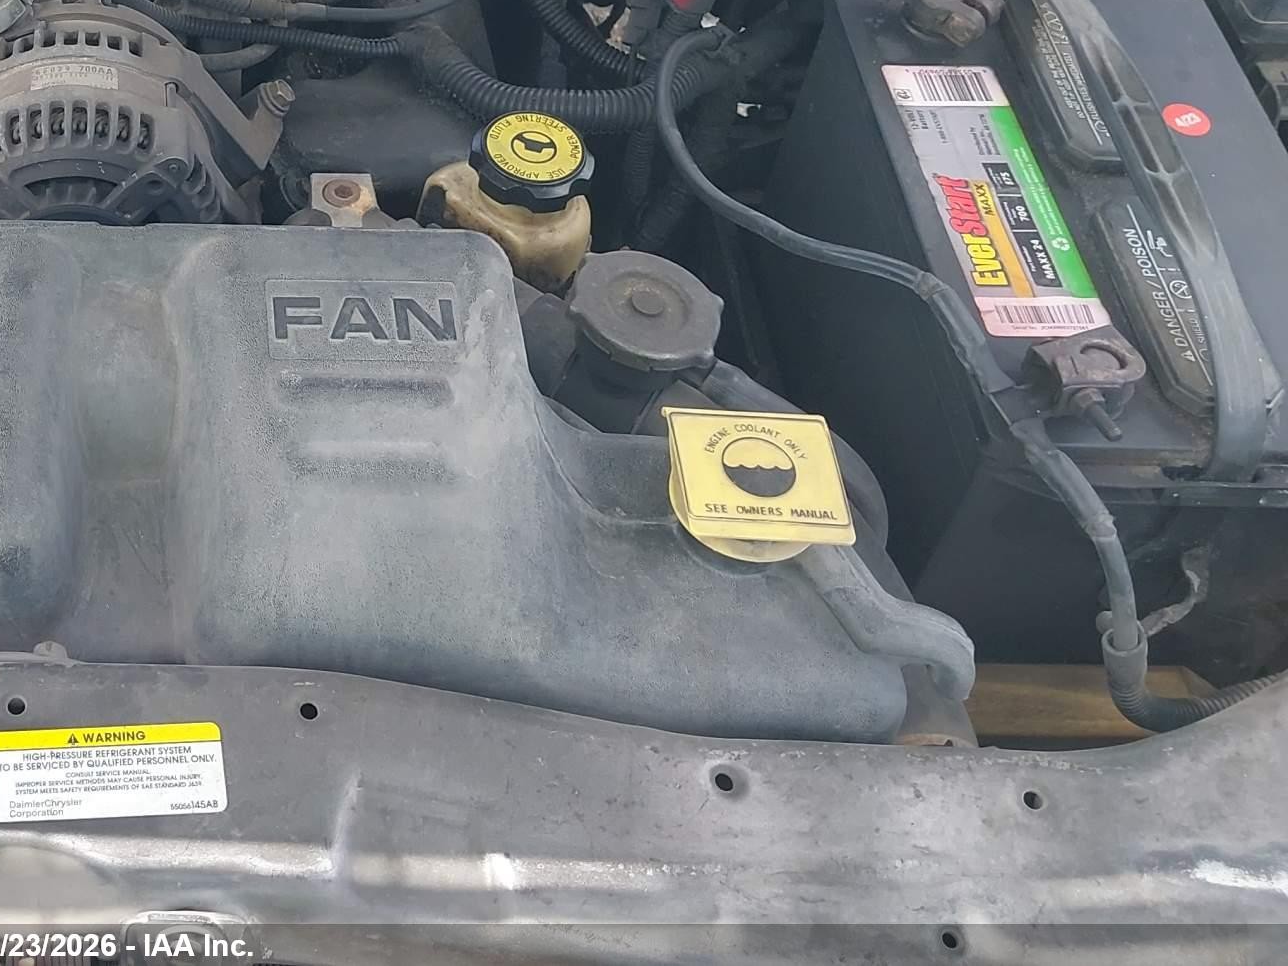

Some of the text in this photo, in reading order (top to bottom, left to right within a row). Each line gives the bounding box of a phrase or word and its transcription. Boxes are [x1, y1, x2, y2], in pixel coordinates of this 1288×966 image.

[489, 114, 581, 179] USE APPROVED POWER STEERING FLUID
[974, 183, 995, 216] MAXX
[1015, 205, 1031, 222] 700
[934, 174, 1010, 287] EverStart
[1029, 239, 1056, 280] MAXX 24
[1122, 228, 1157, 277] POISON
[272, 296, 457, 342] FAN
[1152, 291, 1189, 347] DANGER
[703, 423, 809, 461] ENGINE COOLANT ONLY
[704, 503, 838, 520] SEE OWNERS MANUAL
[83, 731, 146, 744] WARNING
[22, 745, 192, 762] HIGH-PRESSURE REFRIGERANT SYSTEM
[13, 762, 24, 771] BE
[26, 760, 71, 771] SERVICED
[72, 759, 84, 768] BY
[86, 757, 134, 767] QUALIFIED
[136, 755, 189, 765] PERSONNEL
[15, 781, 47, 789] IMPROPER
[48, 779, 73, 787] SERVICE
[75, 778, 106, 786] METHODS
[123, 776, 144, 784] CAUSE
[145, 774, 178, 783] PERSONAL
[95, 769, 121, 777] SERVICE
[15, 788, 39, 796] SYSTEM
[60, 786, 82, 794] SAFETY
[9, 798, 83, 809] DaimlerChrysler
[9, 807, 64, 818] Corporation
